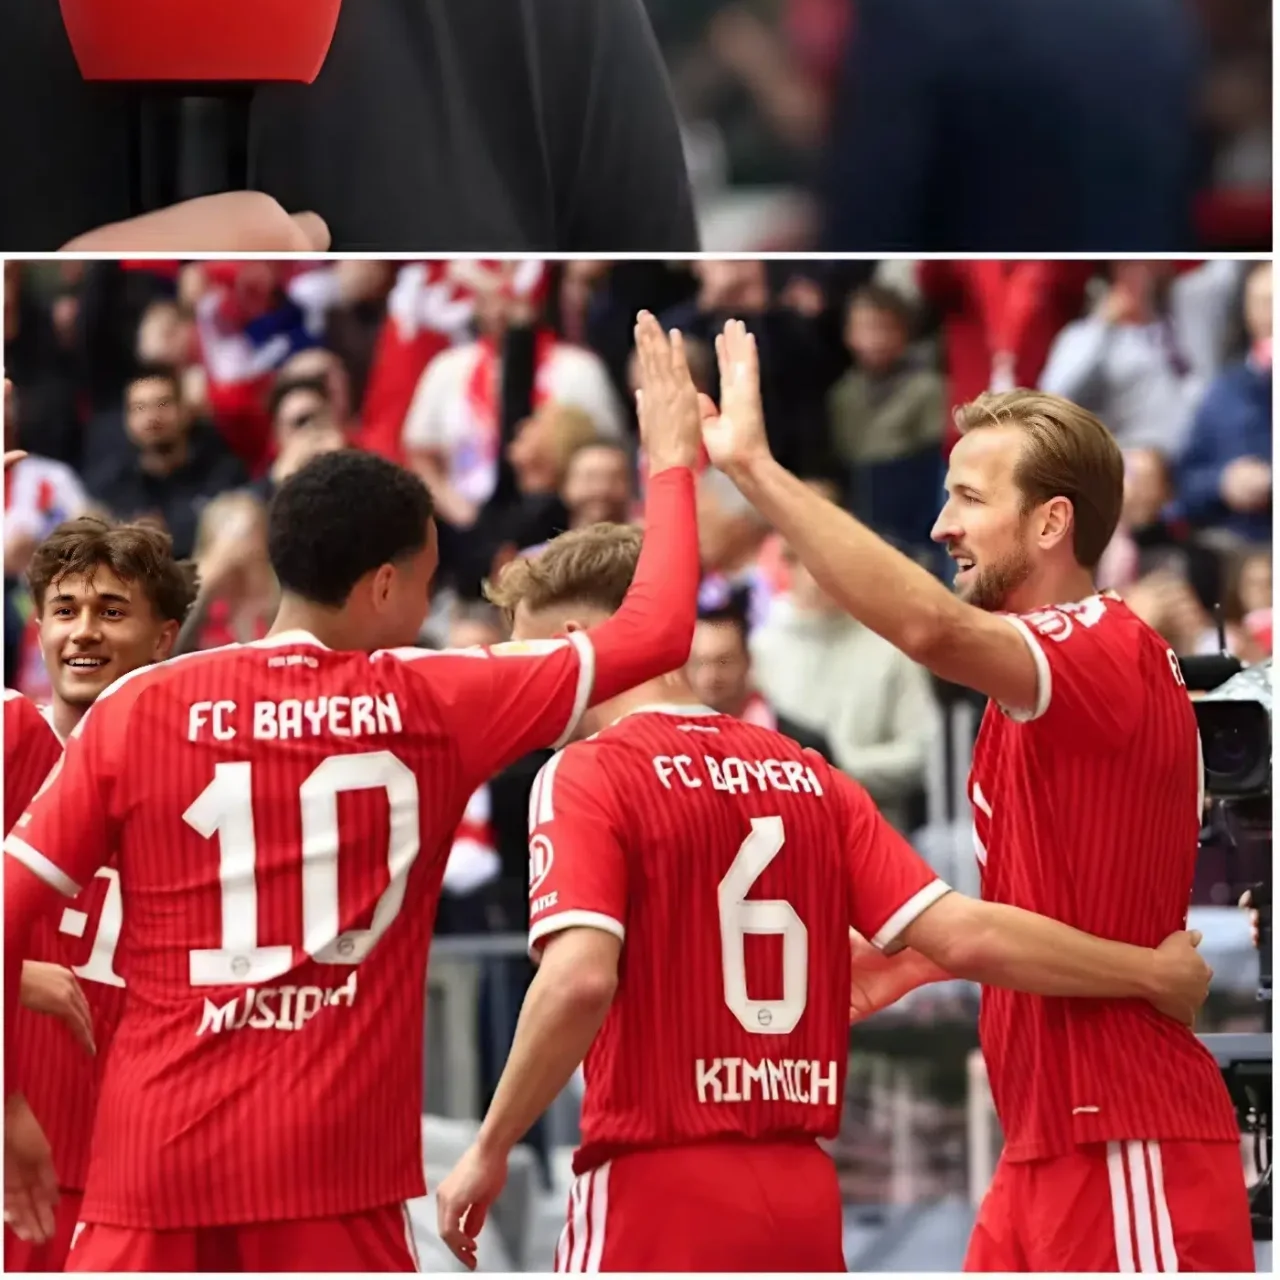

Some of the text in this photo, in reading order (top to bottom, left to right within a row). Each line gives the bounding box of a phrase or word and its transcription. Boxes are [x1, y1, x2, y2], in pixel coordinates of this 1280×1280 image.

[188, 692, 403, 741] FC BAYERN
[652, 754, 703, 790] FC
[181, 749, 421, 987] 10
[717, 815, 809, 1035] 6
[695, 1057, 838, 1106] KIMMICH
